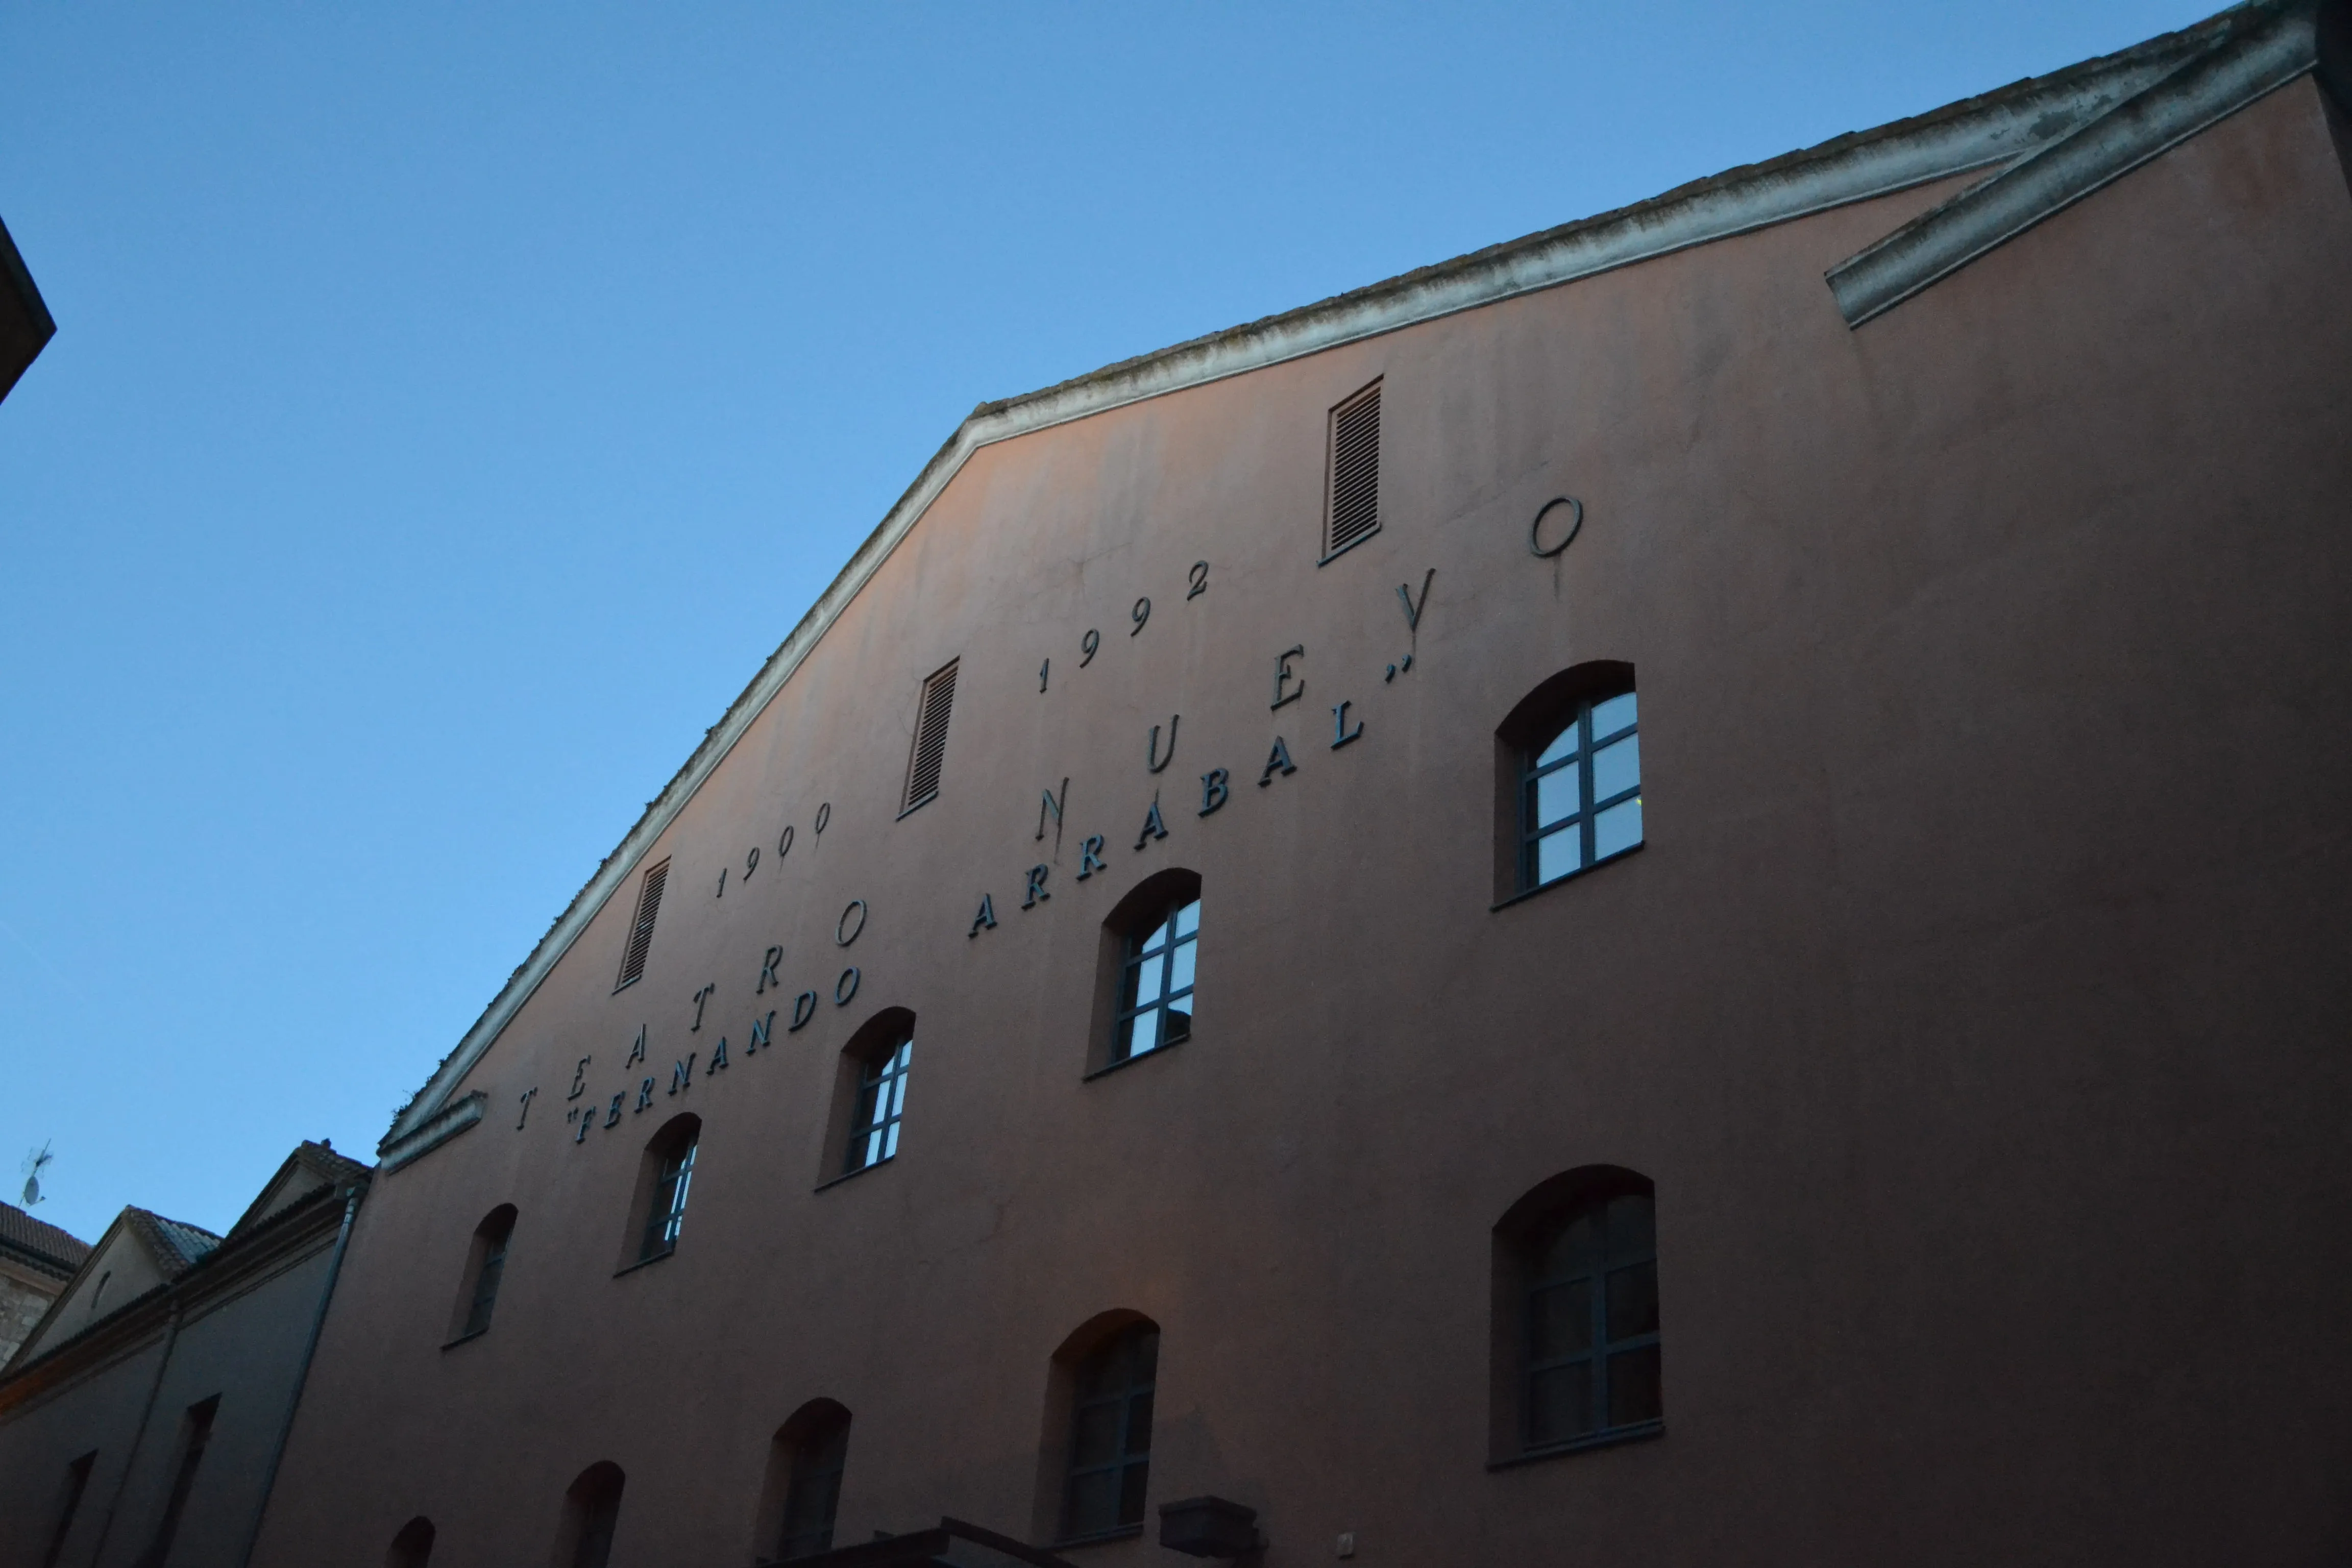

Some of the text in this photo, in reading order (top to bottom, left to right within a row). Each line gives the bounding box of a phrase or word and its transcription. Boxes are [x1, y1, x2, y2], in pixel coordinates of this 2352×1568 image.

[517, 495, 1583, 1131] TEATRO NUEVO
[716, 560, 1209, 898] 1900 1992
